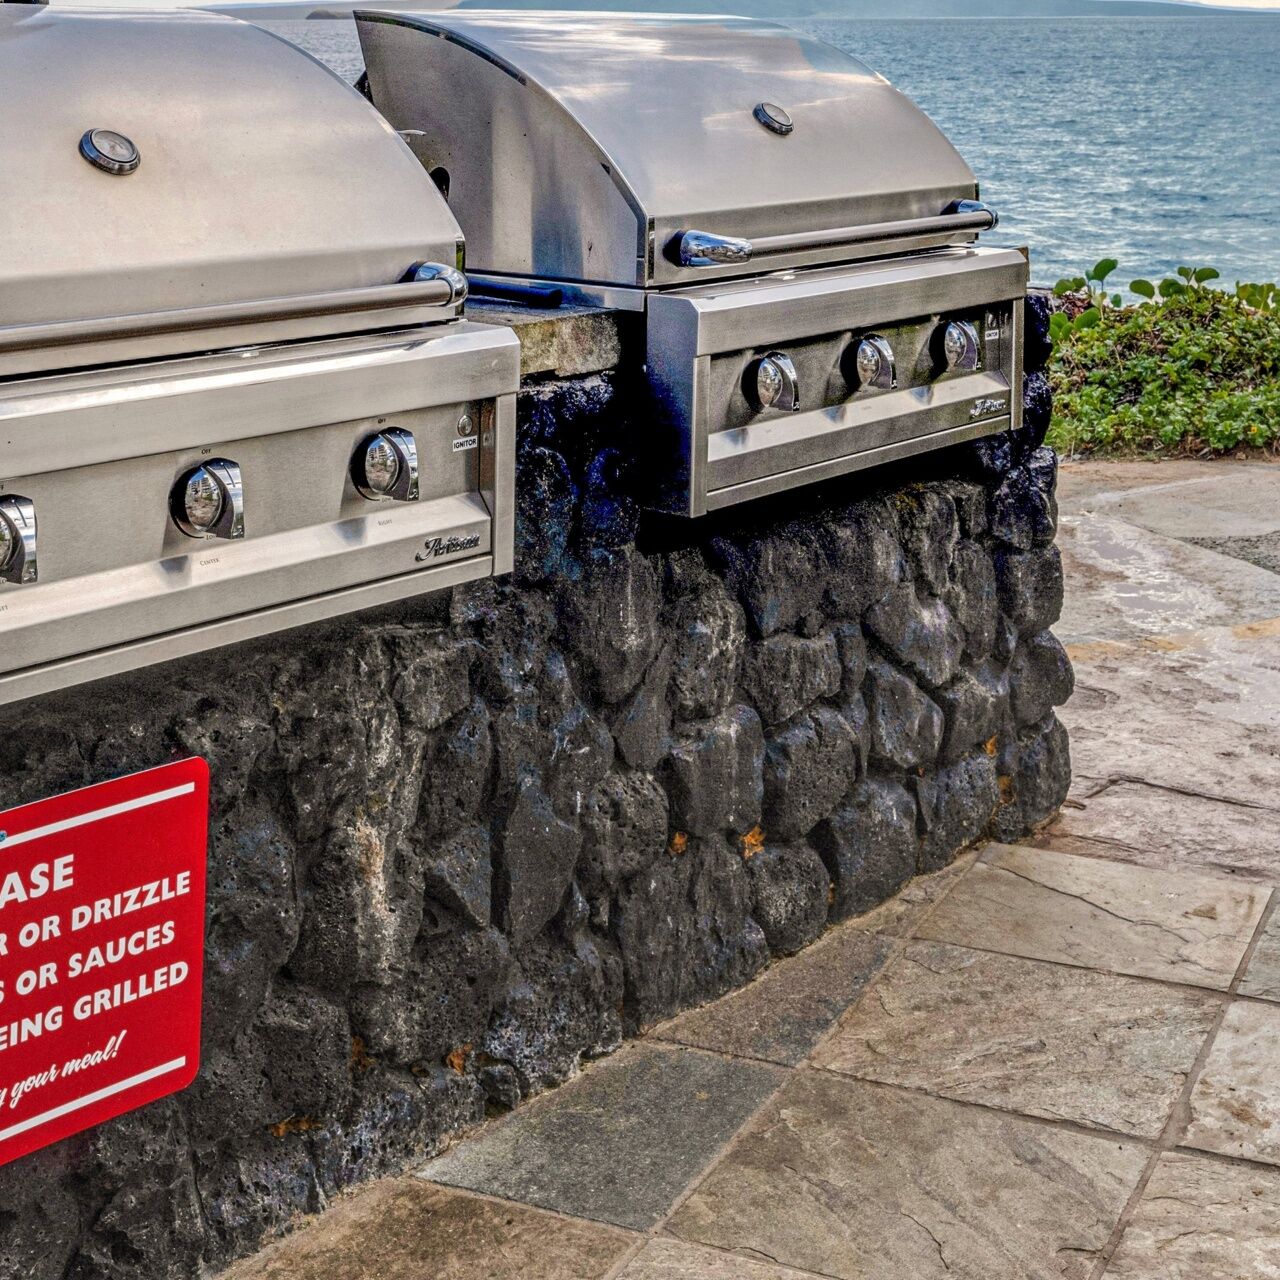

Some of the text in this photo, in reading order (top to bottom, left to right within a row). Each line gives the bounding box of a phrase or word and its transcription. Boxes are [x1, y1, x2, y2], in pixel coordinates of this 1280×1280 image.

[454, 438, 476, 449] IGNITOR
[19, 916, 60, 947] OR
[72, 871, 190, 931] DRIZZLE
[16, 963, 57, 995] OR
[69, 921, 174, 977] SAUCES
[74, 962, 188, 1020] GRILLED
[10, 1064, 59, 1108] your
[62, 1030, 127, 1077] meal!
